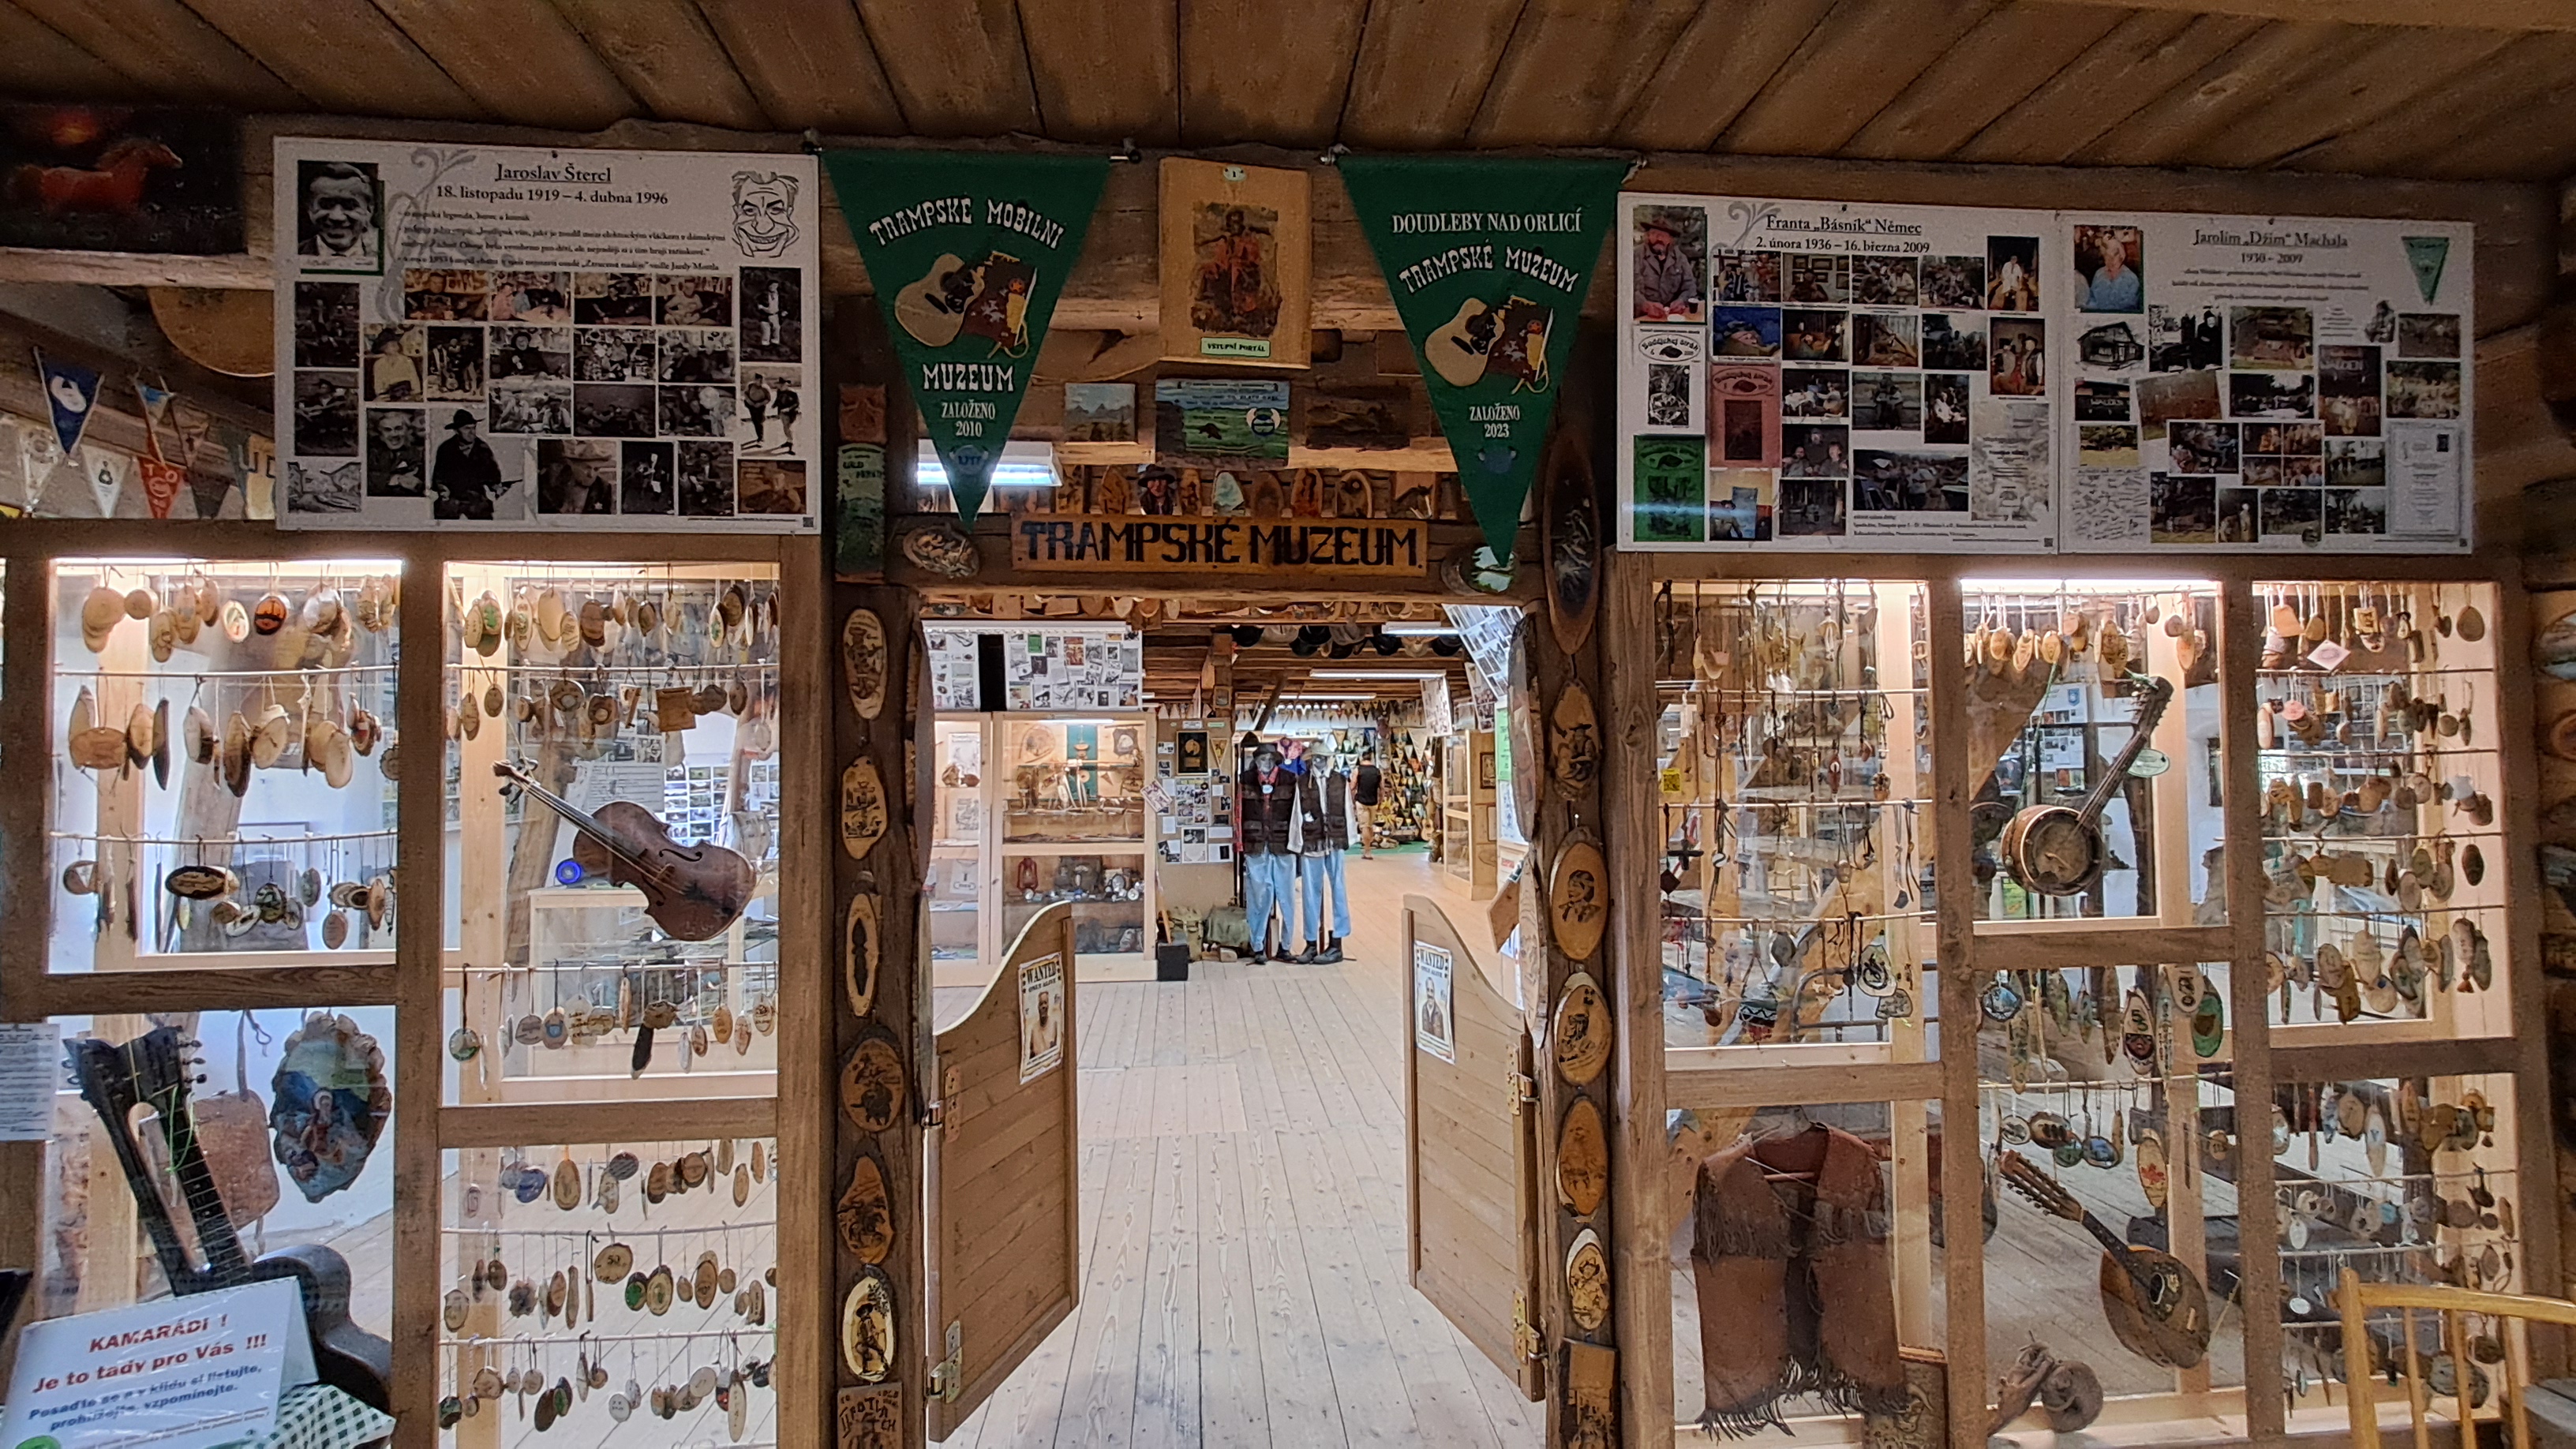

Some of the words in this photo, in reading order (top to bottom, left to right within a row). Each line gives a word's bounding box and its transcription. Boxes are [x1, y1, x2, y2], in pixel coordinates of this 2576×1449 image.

[495, 163, 561, 182] Jaroslav
[564, 163, 612, 182] Štercl
[437, 185, 456, 198] 18.
[460, 187, 523, 202] listopadu
[528, 189, 560, 202] 1919
[575, 190, 587, 203] 4.
[590, 192, 632, 204] dubna
[637, 193, 668, 204] 1996
[1392, 213, 1483, 234] DOUDLEBY
[1487, 213, 1521, 232] NAD
[1524, 207, 1582, 233] ORLICÍ
[1766, 214, 1810, 230] Franta
[1875, 218, 1922, 234] Němec
[1756, 236, 1767, 248] 2.
[1769, 238, 1802, 249] února
[1806, 238, 1832, 250] 1936
[1844, 240, 1861, 252] 16.
[1903, 242, 1930, 253] 2009
[2295, 232, 2348, 248] Machala
[1398, 238, 1494, 294] TRAMPSKÉ
[1505, 245, 1579, 293] MUZEUM
[1208, 342, 1237, 350] VSTUPNÍ
[1239, 343, 1266, 352] PORTÁL
[923, 363, 1014, 391] MUZEUM
[941, 399, 996, 420] ZALOŽENO
[1469, 402, 1521, 421] ZALOŽENO
[955, 420, 983, 438] 2010
[1484, 422, 1510, 438] 2023
[1020, 518, 1240, 564] TRAMPSKÉ
[1250, 524, 1419, 567] MUZEUM
[1421, 950, 1444, 971] WANTED
[1027, 961, 1057, 986] WANTED
[88, 1316, 210, 1354] KAMARÁDI
[32, 1377, 59, 1394] Je
[66, 1372, 90, 1387] to
[152, 1352, 189, 1372] pro
[196, 1341, 235, 1360] Vás
[144, 1383, 238, 1409] vzpomínejte.
